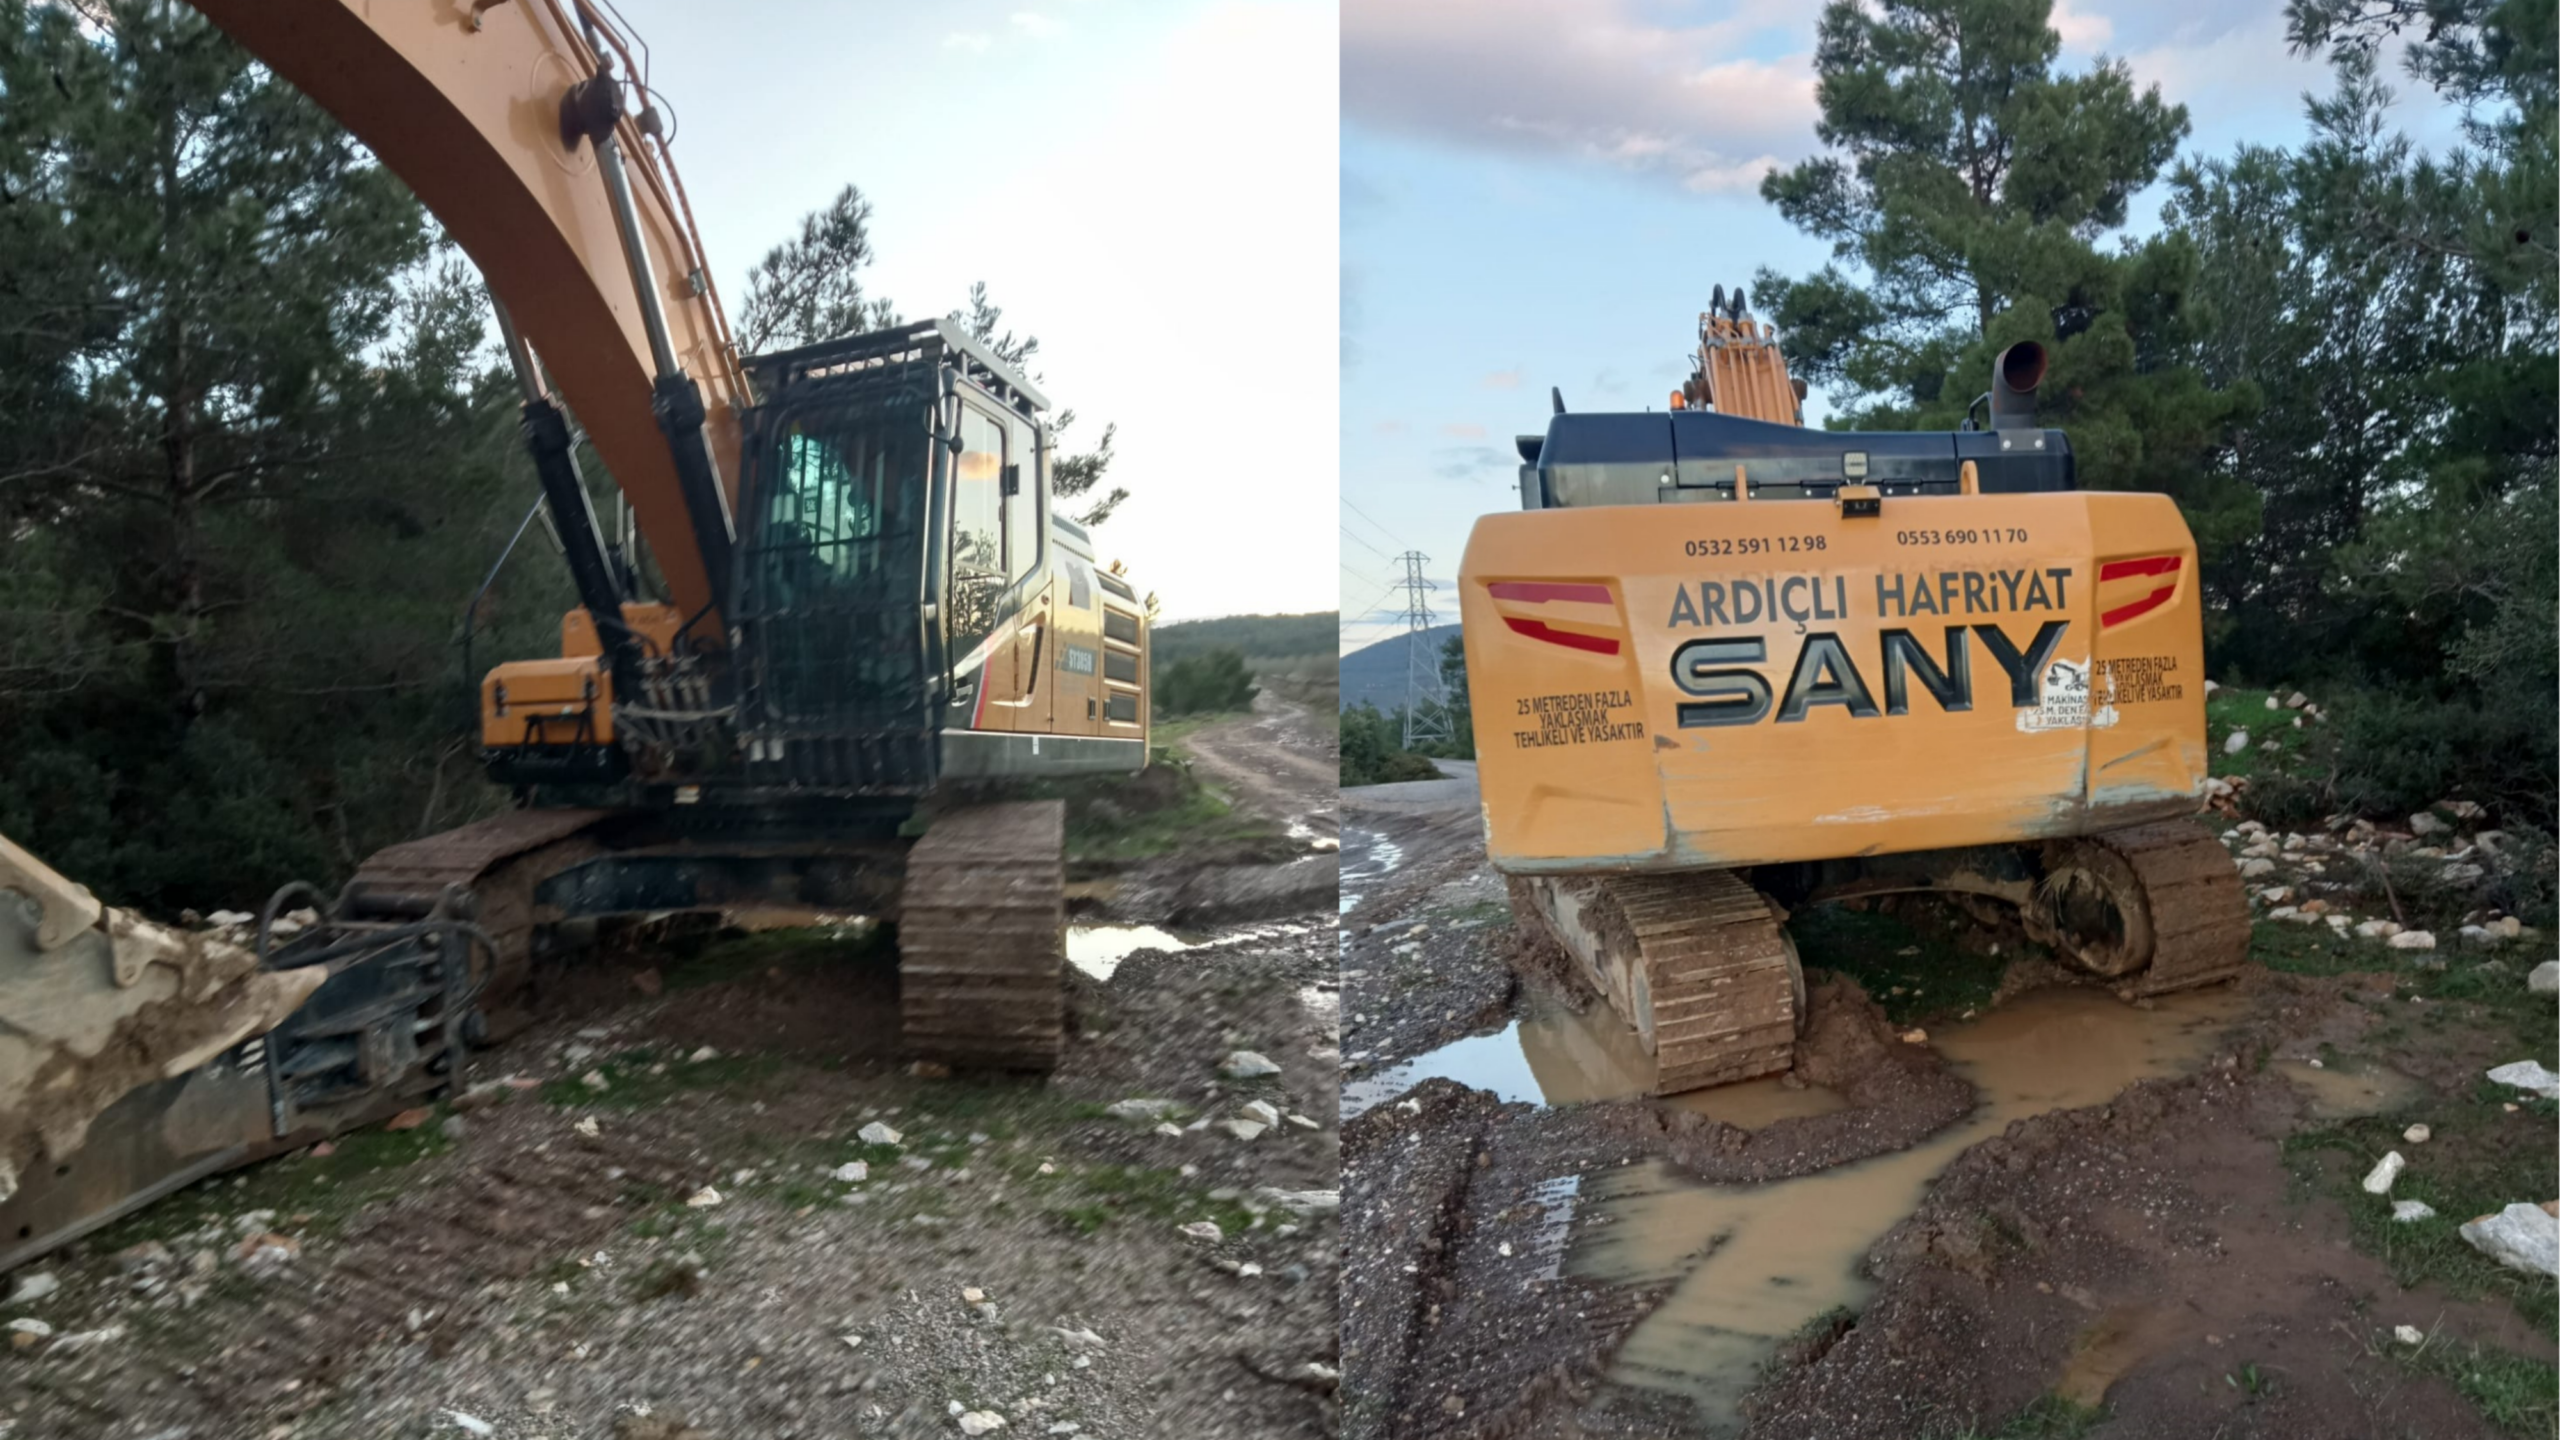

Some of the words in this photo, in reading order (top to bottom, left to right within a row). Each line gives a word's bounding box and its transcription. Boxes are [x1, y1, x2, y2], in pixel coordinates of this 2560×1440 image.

[1685, 539, 1732, 556] 0532
[1738, 537, 1770, 554] 591
[1778, 536, 1800, 552] 12
[1803, 535, 1827, 551] 98
[1897, 530, 1941, 545] 0553
[1945, 529, 1977, 544] 690
[1982, 529, 2001, 543] 11
[2006, 528, 2027, 543] 70
[1667, 575, 1848, 635] ARDIÇLI
[1670, 620, 2071, 729] SANY
[2096, 660, 2106, 675] 25
[2108, 657, 2152, 674] METREDEN
[2153, 656, 2177, 672] FAZLA
[1517, 699, 1530, 715] 25
[1532, 693, 1593, 714] METREDEN
[1594, 690, 1632, 709] FAZLA
[1570, 726, 1585, 744] VE
[1587, 722, 1644, 743] YASAKTIR
